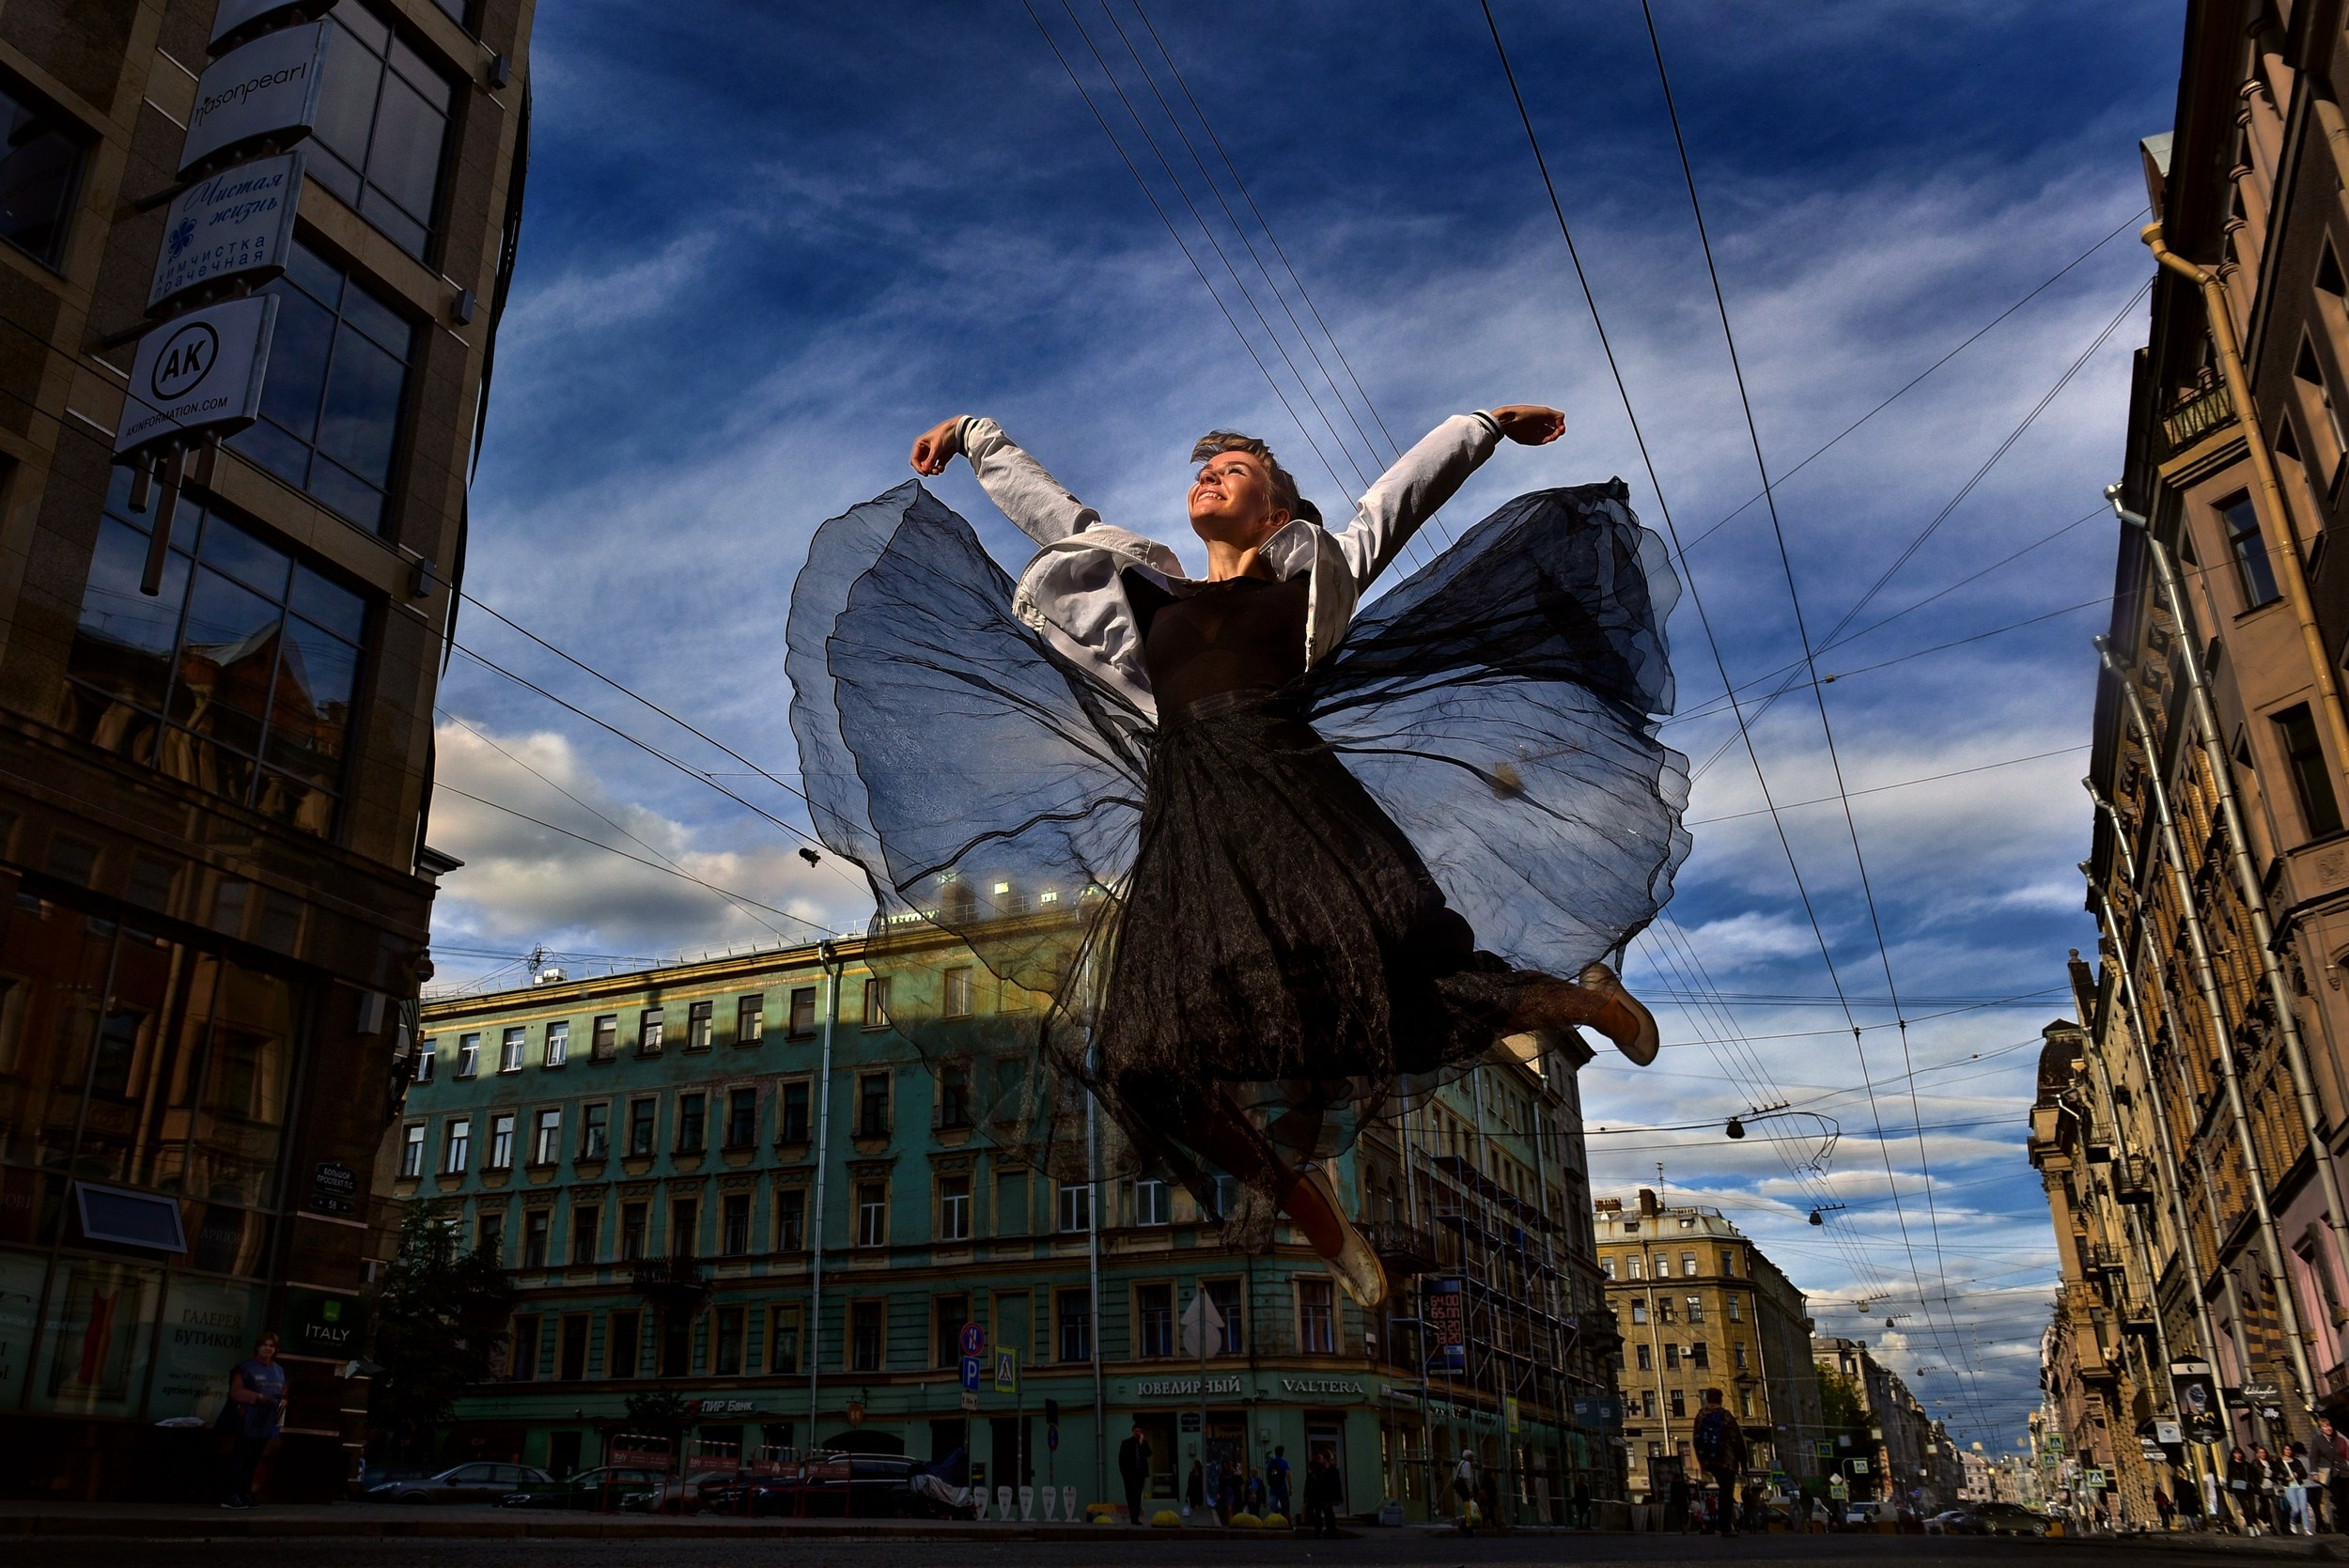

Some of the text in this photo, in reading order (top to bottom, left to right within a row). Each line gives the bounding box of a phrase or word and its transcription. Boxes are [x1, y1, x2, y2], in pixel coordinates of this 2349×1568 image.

[183, 174, 283, 212] Чистая
[210, 197, 278, 225] жизнь
[157, 236, 265, 285] химчистка
[153, 250, 264, 300] прачечная
[161, 339, 206, 383] AK
[125, 396, 228, 438] AKINFORMATION.COM
[317, 1174, 344, 1188] ПРОСПЕКТ
[329, 1200, 337, 1210] 58
[182, 1309, 241, 1330] ГАЛЕРЕЯ
[175, 1328, 243, 1350] БУТИКОВ
[305, 1322, 351, 1342] ITALY
[1282, 1378, 1364, 1393] VALTERA
[701, 1400, 754, 1413] ПИР Банк
